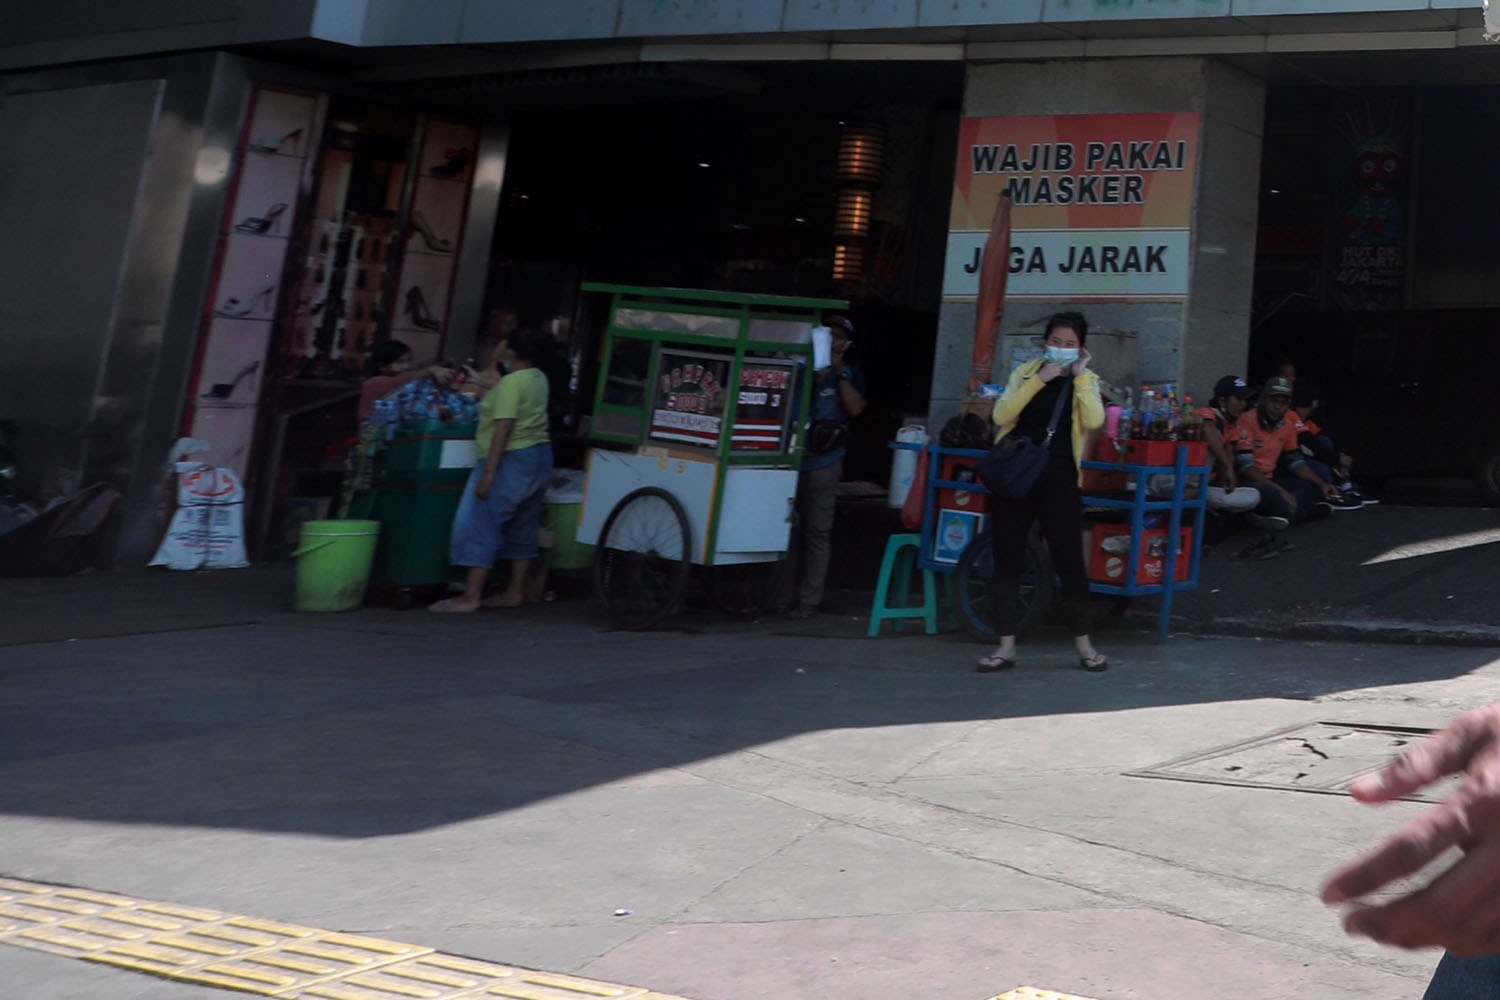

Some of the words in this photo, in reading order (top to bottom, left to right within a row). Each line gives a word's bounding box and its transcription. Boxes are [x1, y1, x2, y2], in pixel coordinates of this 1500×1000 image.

[971, 143, 1074, 173] WAJIB
[1085, 141, 1187, 171] PAKAI
[1007, 174, 1145, 204] MASKER
[964, 247, 1046, 274] JGA
[1059, 245, 1169, 273] JARAK
